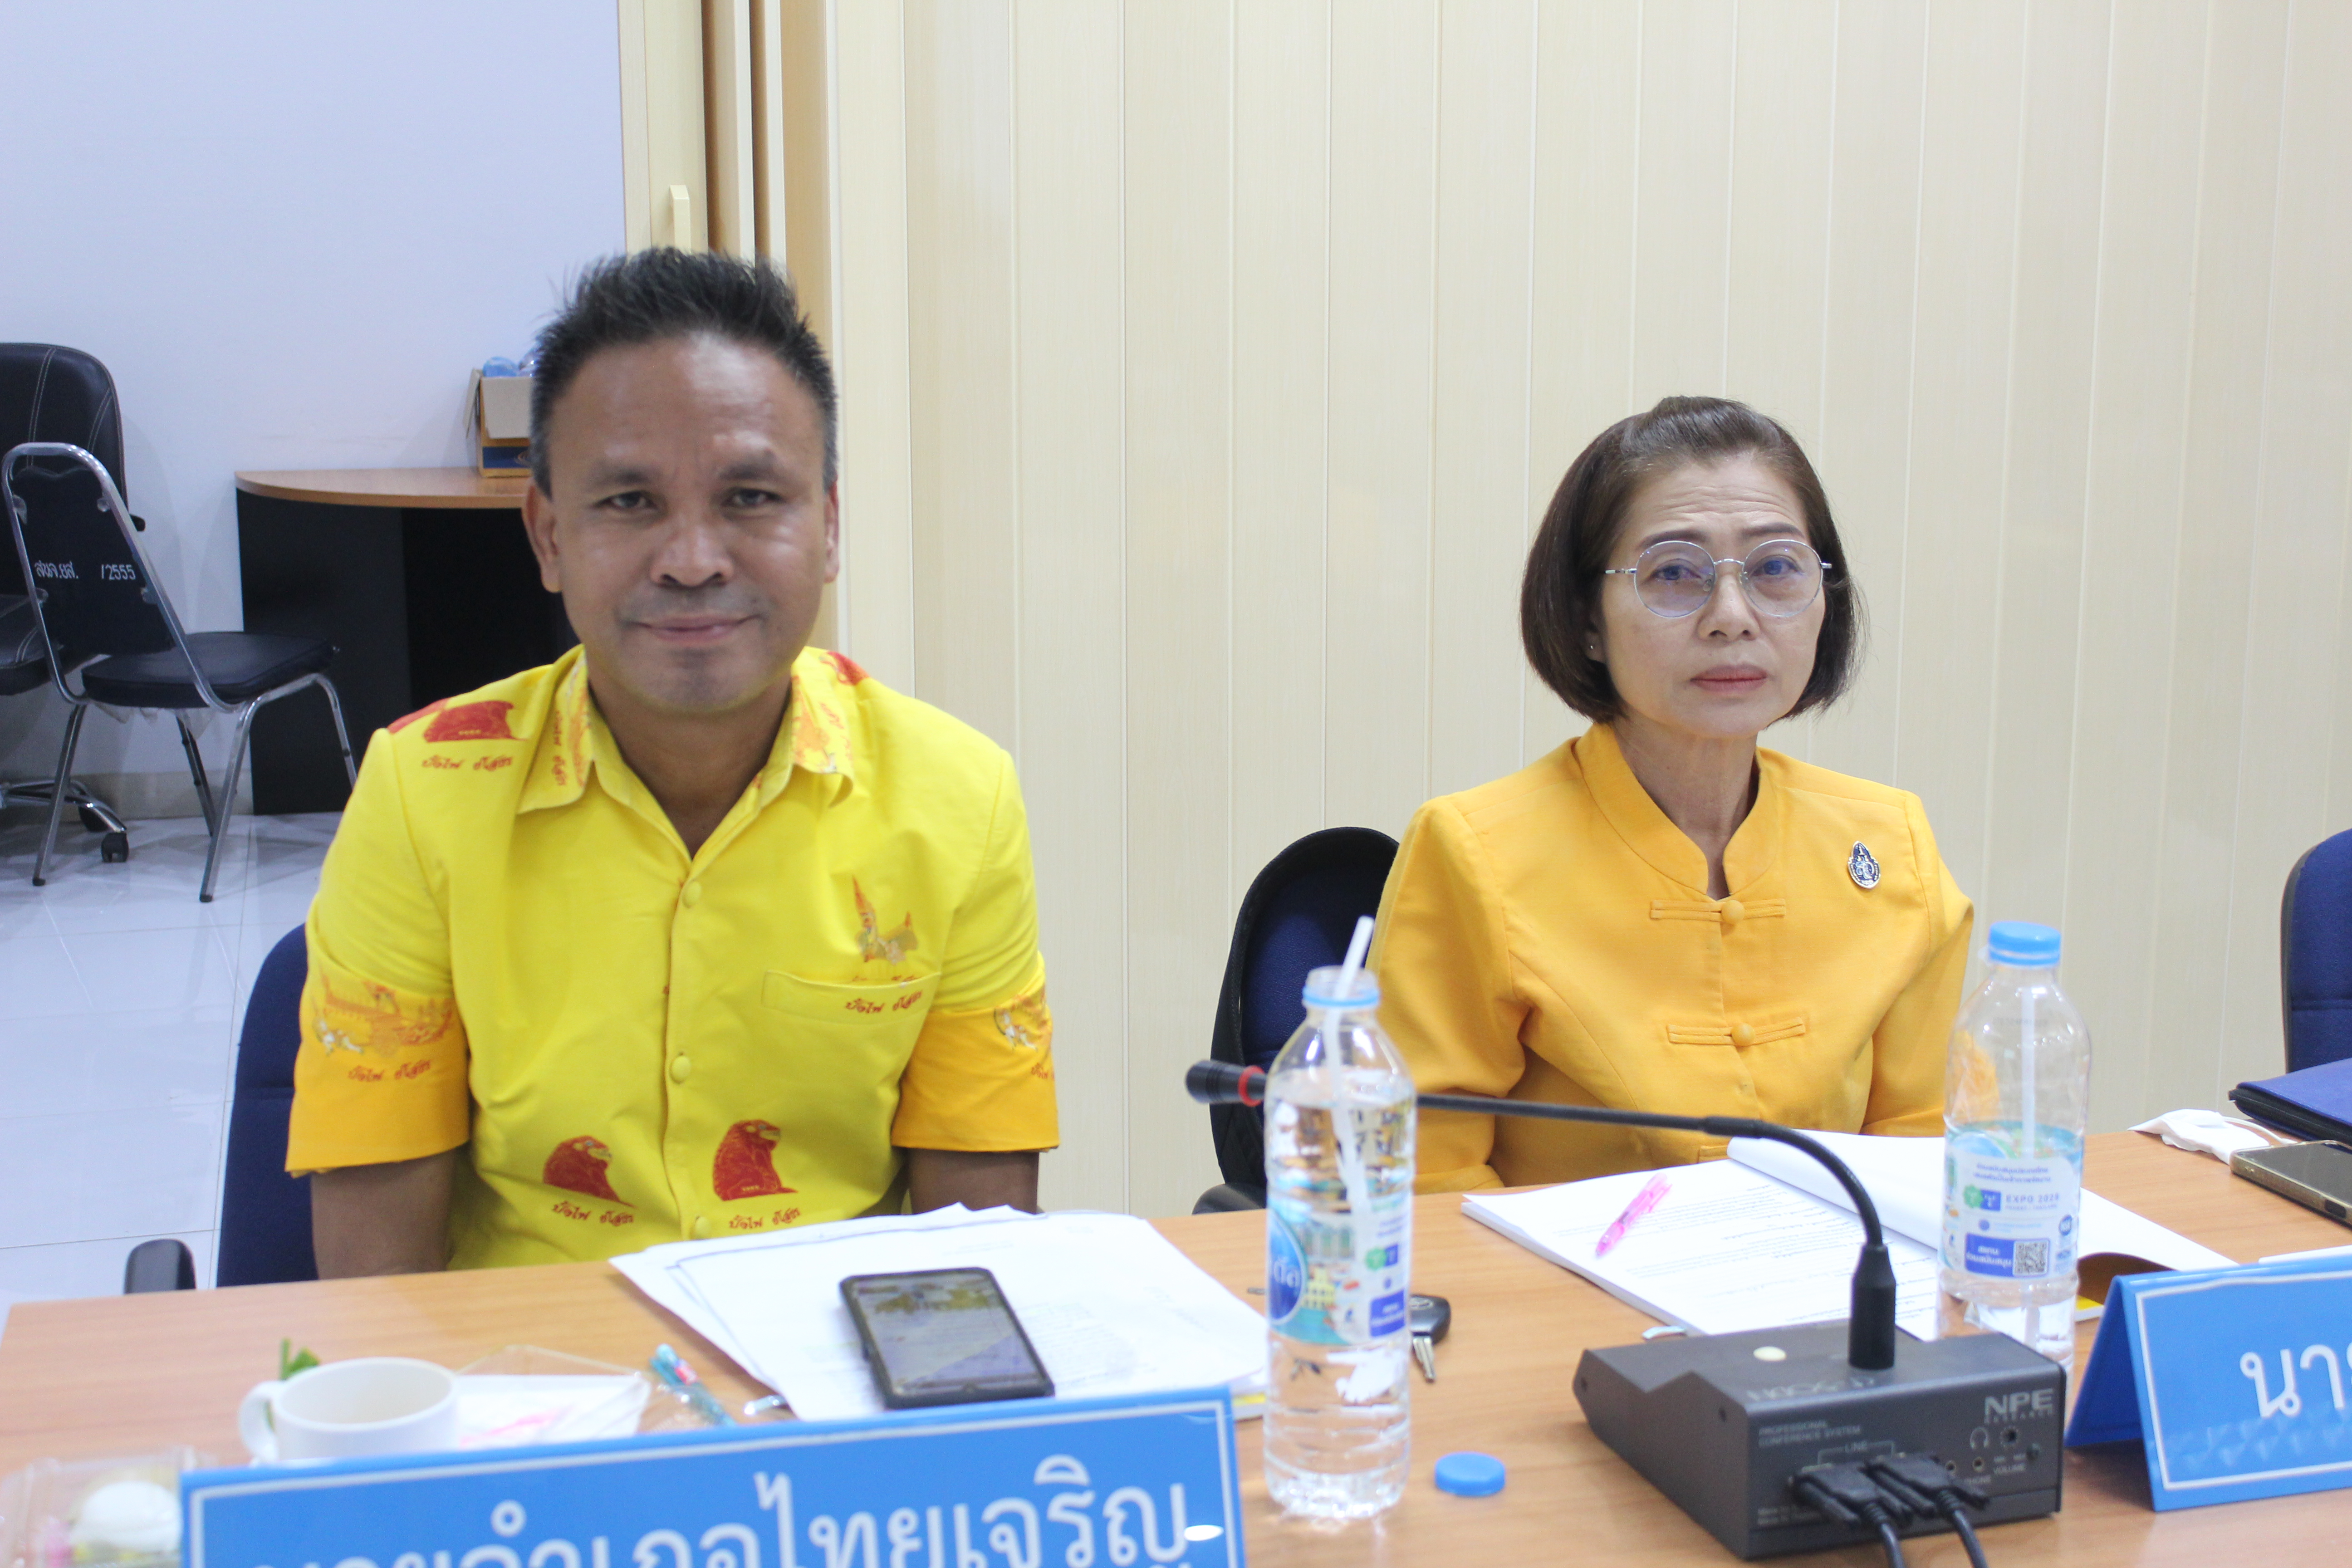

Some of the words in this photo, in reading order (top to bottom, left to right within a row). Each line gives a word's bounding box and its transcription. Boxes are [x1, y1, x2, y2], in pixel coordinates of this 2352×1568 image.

[2006, 1194, 2034, 1204] EXPO
[2239, 1342, 2352, 1418] นา
[1984, 1388, 2053, 1416] NPE
